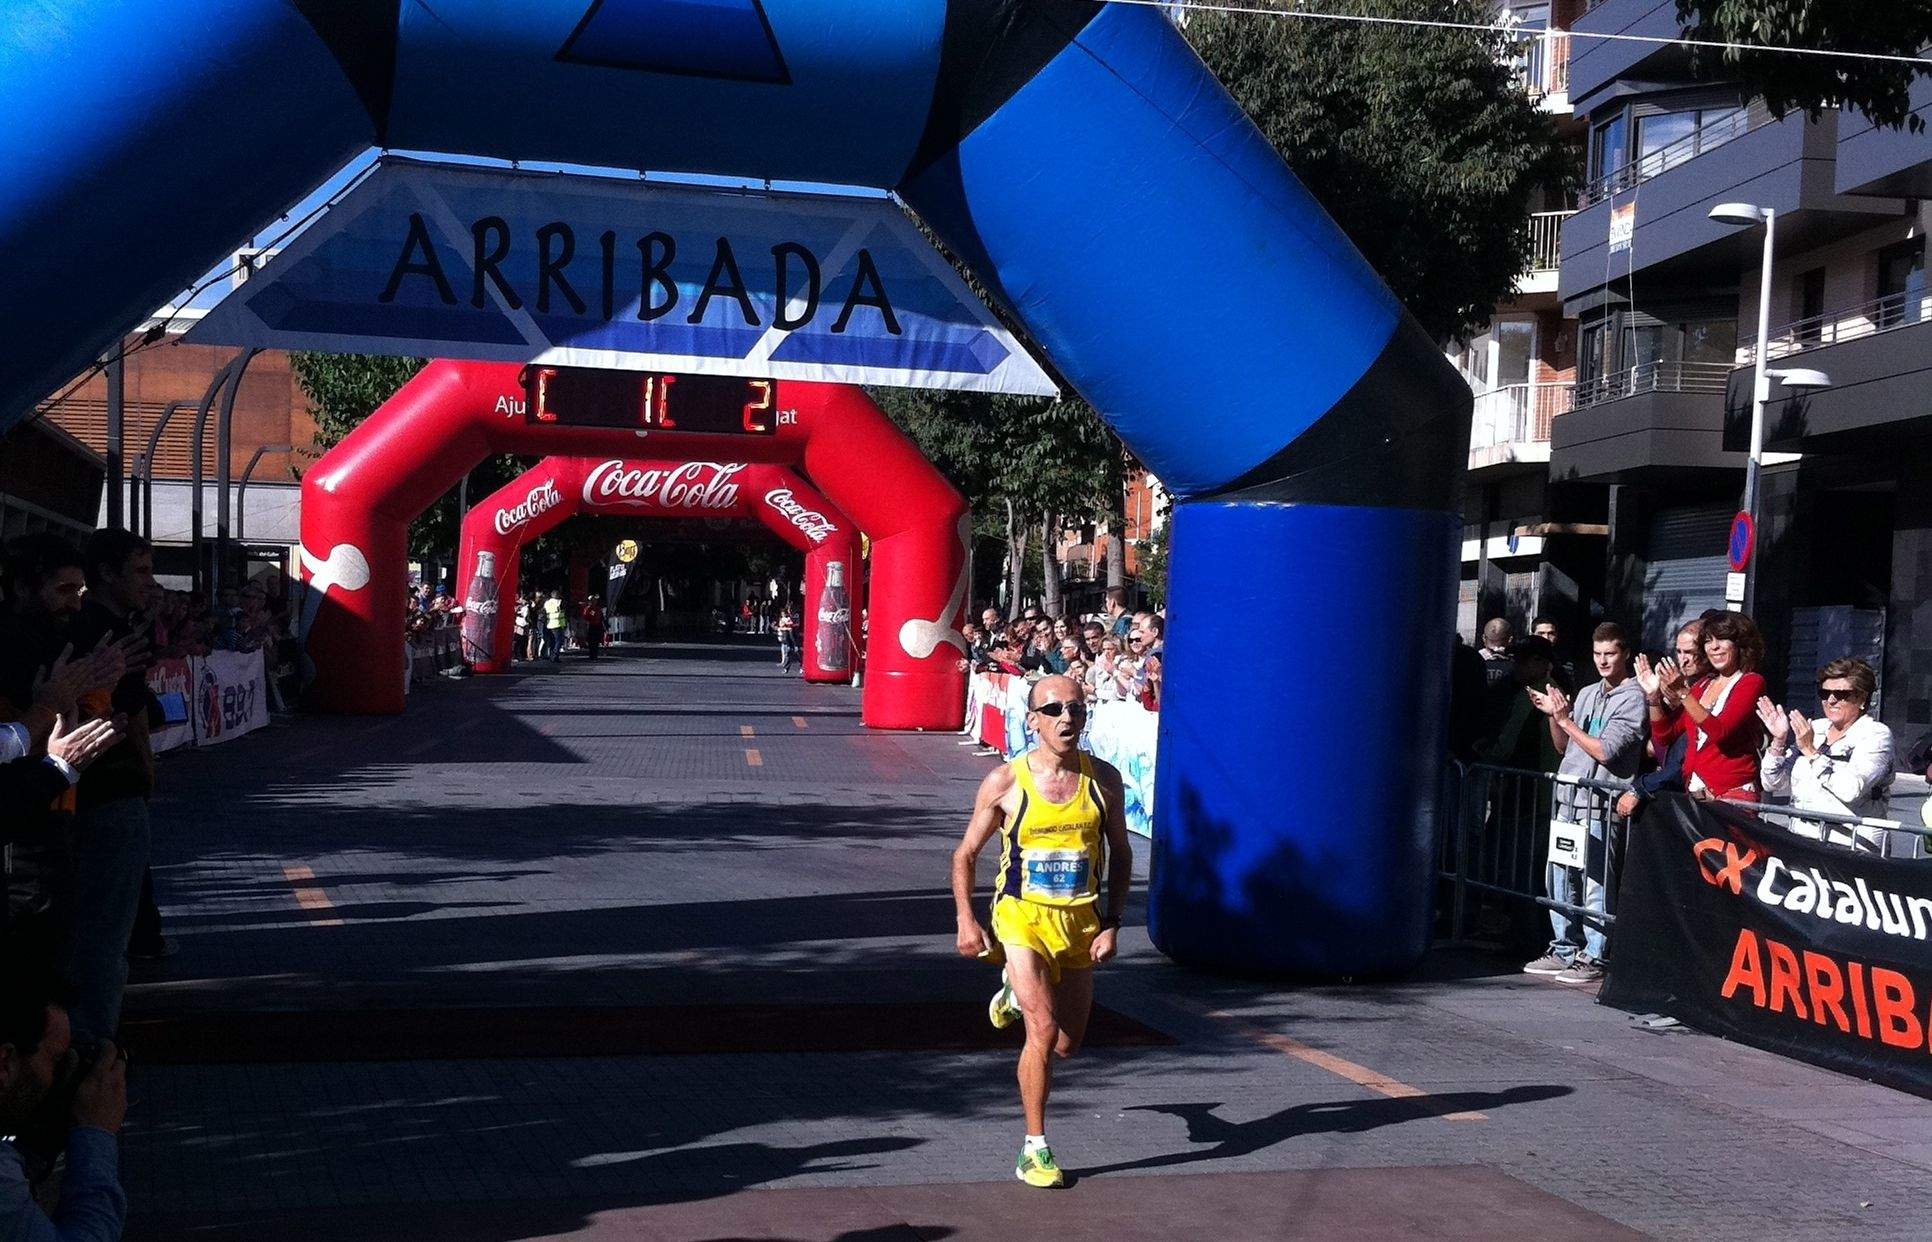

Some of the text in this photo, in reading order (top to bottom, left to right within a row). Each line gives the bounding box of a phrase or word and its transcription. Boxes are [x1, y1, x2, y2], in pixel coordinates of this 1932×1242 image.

[378, 212, 903, 335] ARRIBADA
[495, 478, 562, 535] Coca-Cola
[582, 459, 748, 508] Coca-Cola
[764, 489, 838, 543] Coca-Cola
[1035, 861, 1083, 873] ANDRES
[1053, 874, 1066, 883] 62
[1720, 927, 1932, 1055] ARRIB
